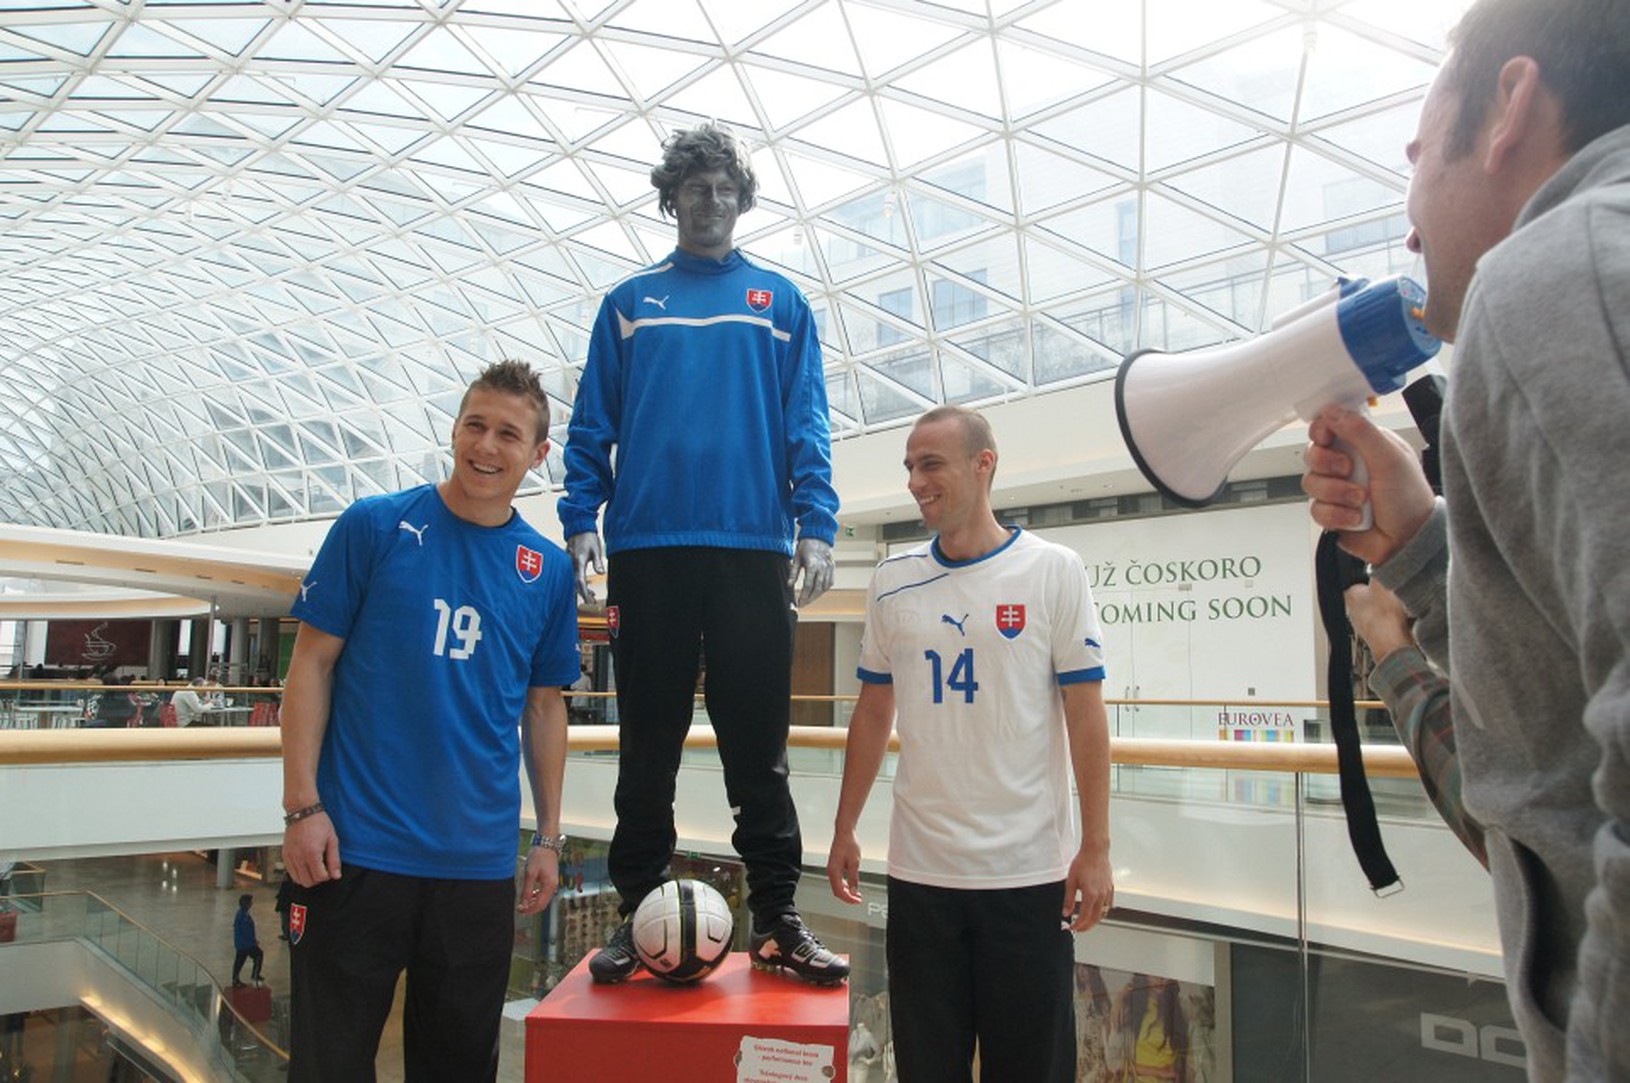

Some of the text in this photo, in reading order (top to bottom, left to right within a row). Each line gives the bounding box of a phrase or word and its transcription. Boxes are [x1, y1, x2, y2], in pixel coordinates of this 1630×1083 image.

[1125, 556, 1262, 585] ČOSKORO
[1094, 595, 1292, 625] OMING SOON
[433, 598, 483, 660] 19
[924, 648, 979, 704] 14
[1218, 711, 1294, 727] EUROVEA
